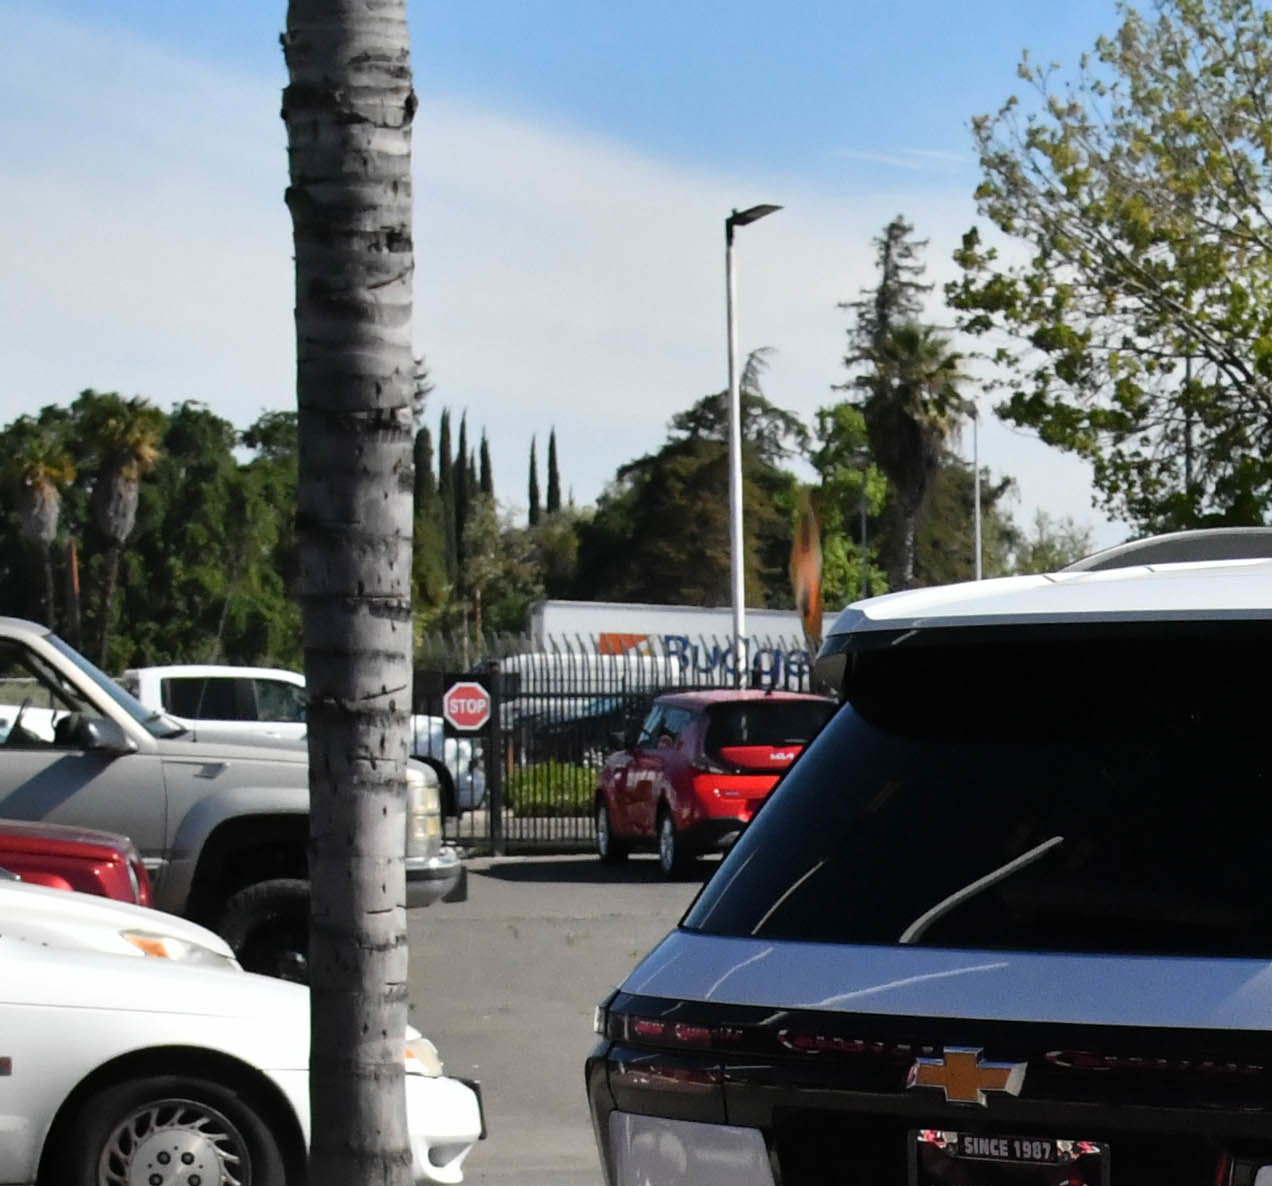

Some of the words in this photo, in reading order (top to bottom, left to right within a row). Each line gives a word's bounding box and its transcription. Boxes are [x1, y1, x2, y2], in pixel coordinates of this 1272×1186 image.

[450, 698, 486, 714] STOP
[964, 1137, 1008, 1157] SINCE
[1014, 1141, 1051, 1159] 1987
